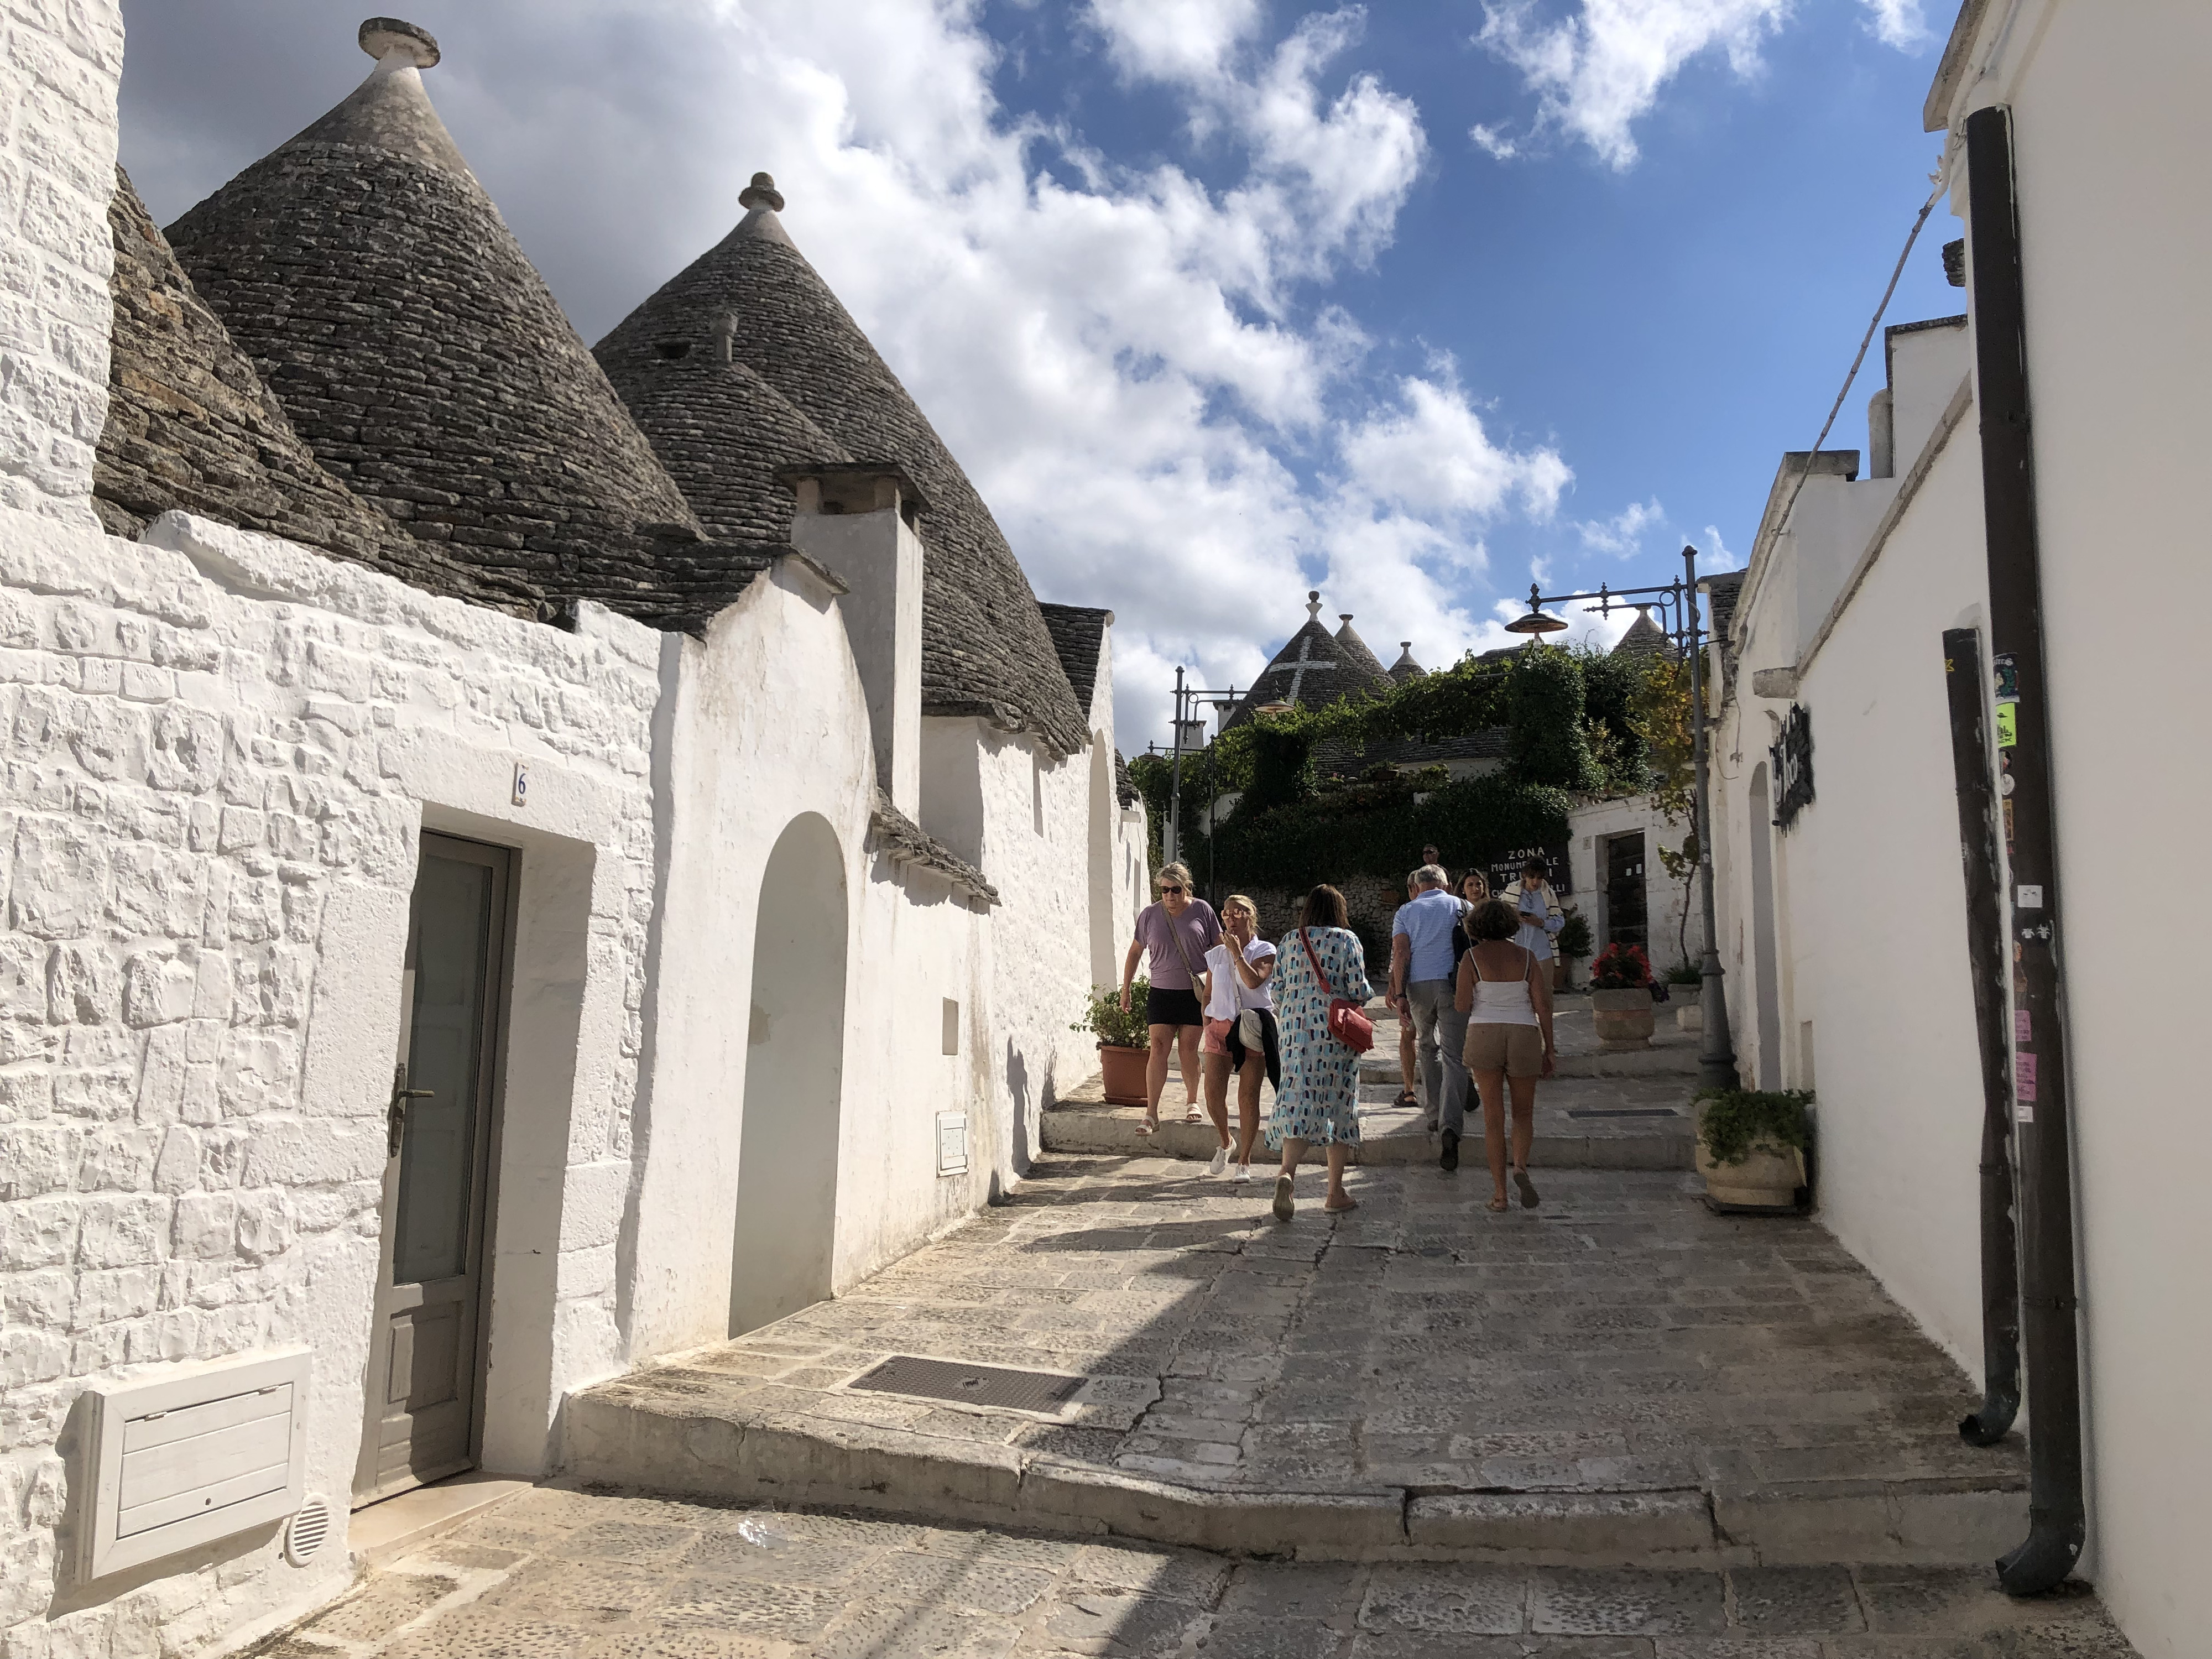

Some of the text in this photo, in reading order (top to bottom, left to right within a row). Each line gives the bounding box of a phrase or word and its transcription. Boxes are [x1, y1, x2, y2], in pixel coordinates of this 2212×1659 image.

[518, 773, 526, 794] 6
[1507, 846, 1545, 859] ZONA
[1491, 857, 1559, 873] MONUMELE
